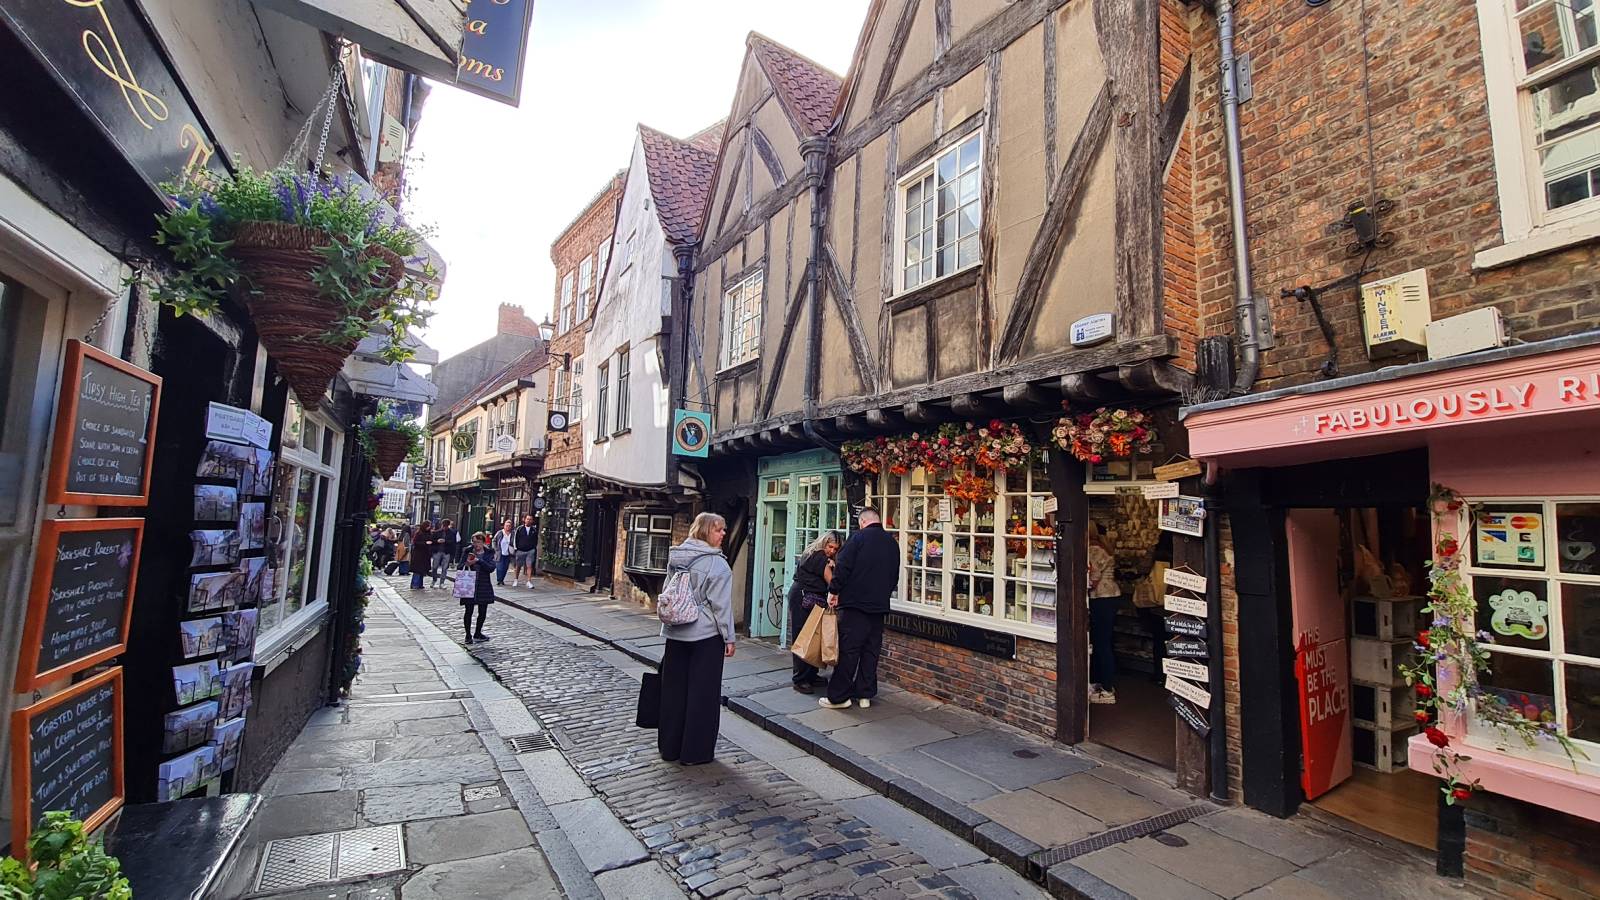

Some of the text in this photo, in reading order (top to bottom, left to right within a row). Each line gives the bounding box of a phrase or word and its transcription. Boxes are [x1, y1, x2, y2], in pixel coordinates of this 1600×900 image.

[1375, 289, 1389, 330] MINSTER
[1373, 330, 1397, 339] ALARMS
[130, 390, 141, 407] TEA
[1314, 372, 1600, 434] FABULOUSLY RI
[883, 613, 911, 630] LITTLE
[1303, 626, 1320, 645] THIS
[1305, 647, 1328, 670] MUST
[1307, 666, 1336, 693] BE THE
[36, 710, 73, 737] TOASTED
[76, 696, 98, 716] CHEESE
[1308, 684, 1347, 726] PLACE
[36, 778, 56, 800] TUNA
